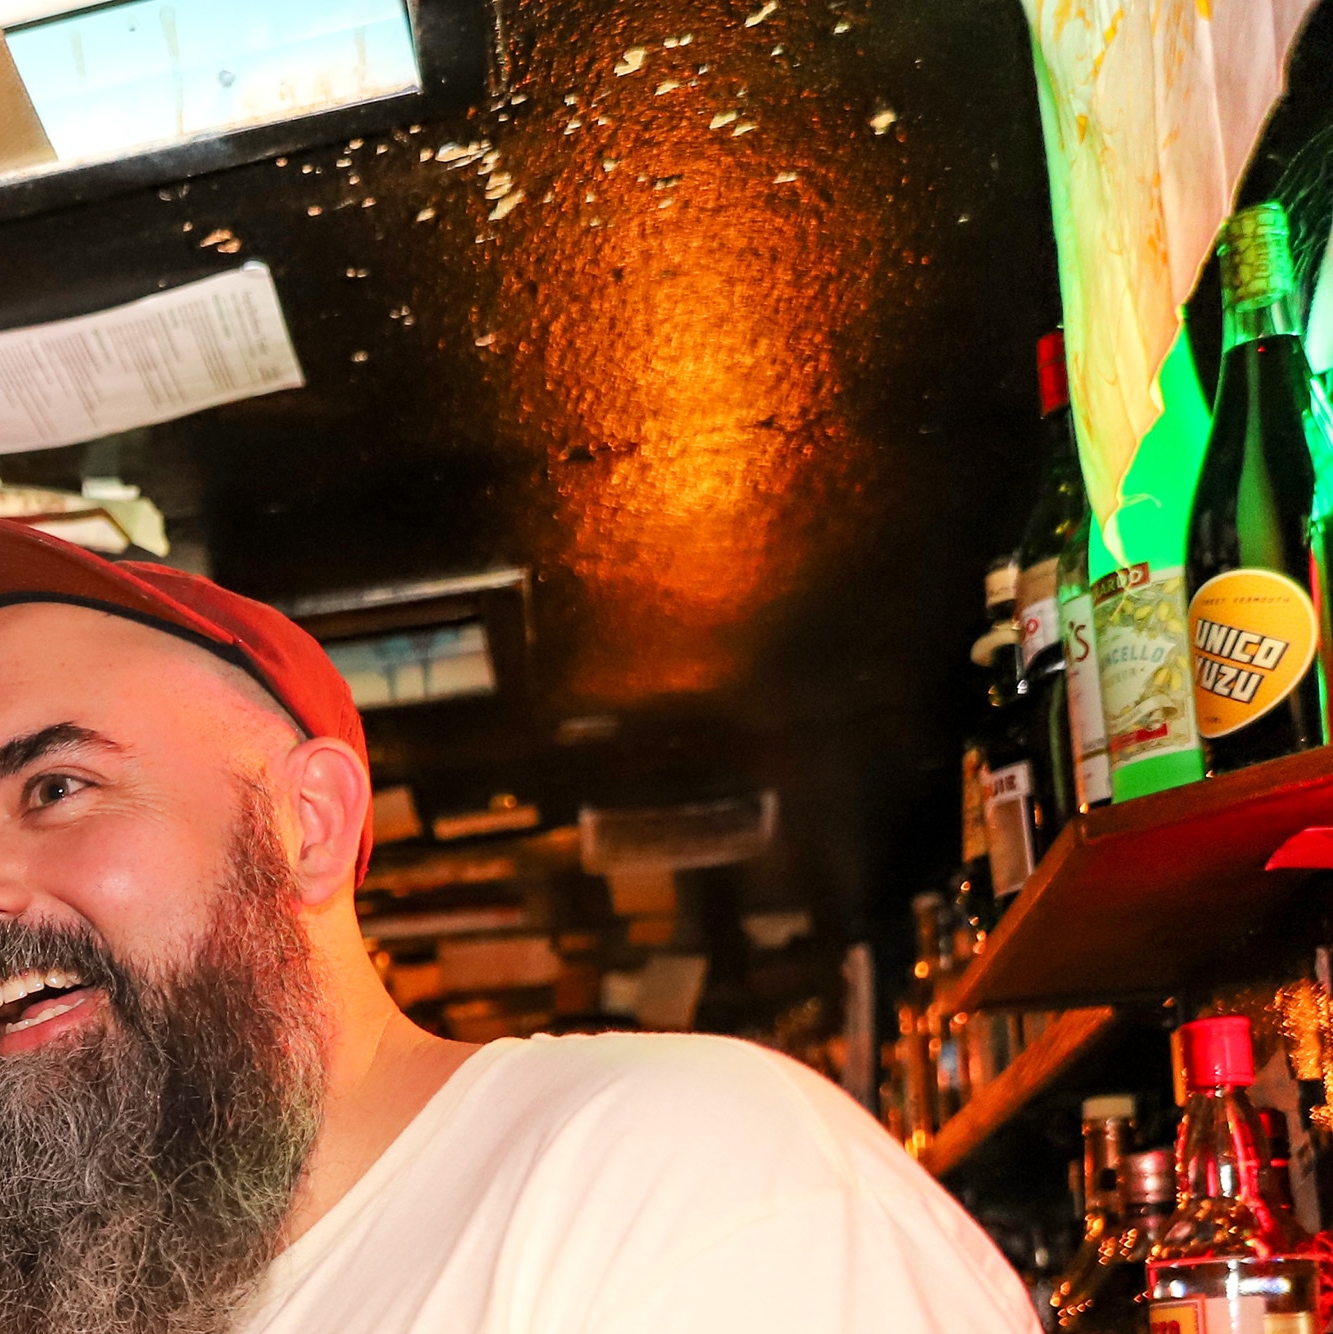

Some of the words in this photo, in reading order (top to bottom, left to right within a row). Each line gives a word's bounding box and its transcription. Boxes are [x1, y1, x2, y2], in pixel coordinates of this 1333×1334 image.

[1095, 567, 1144, 600] ARDO
[1106, 645, 1165, 668] CELLO
[1194, 617, 1290, 672] UNICO
